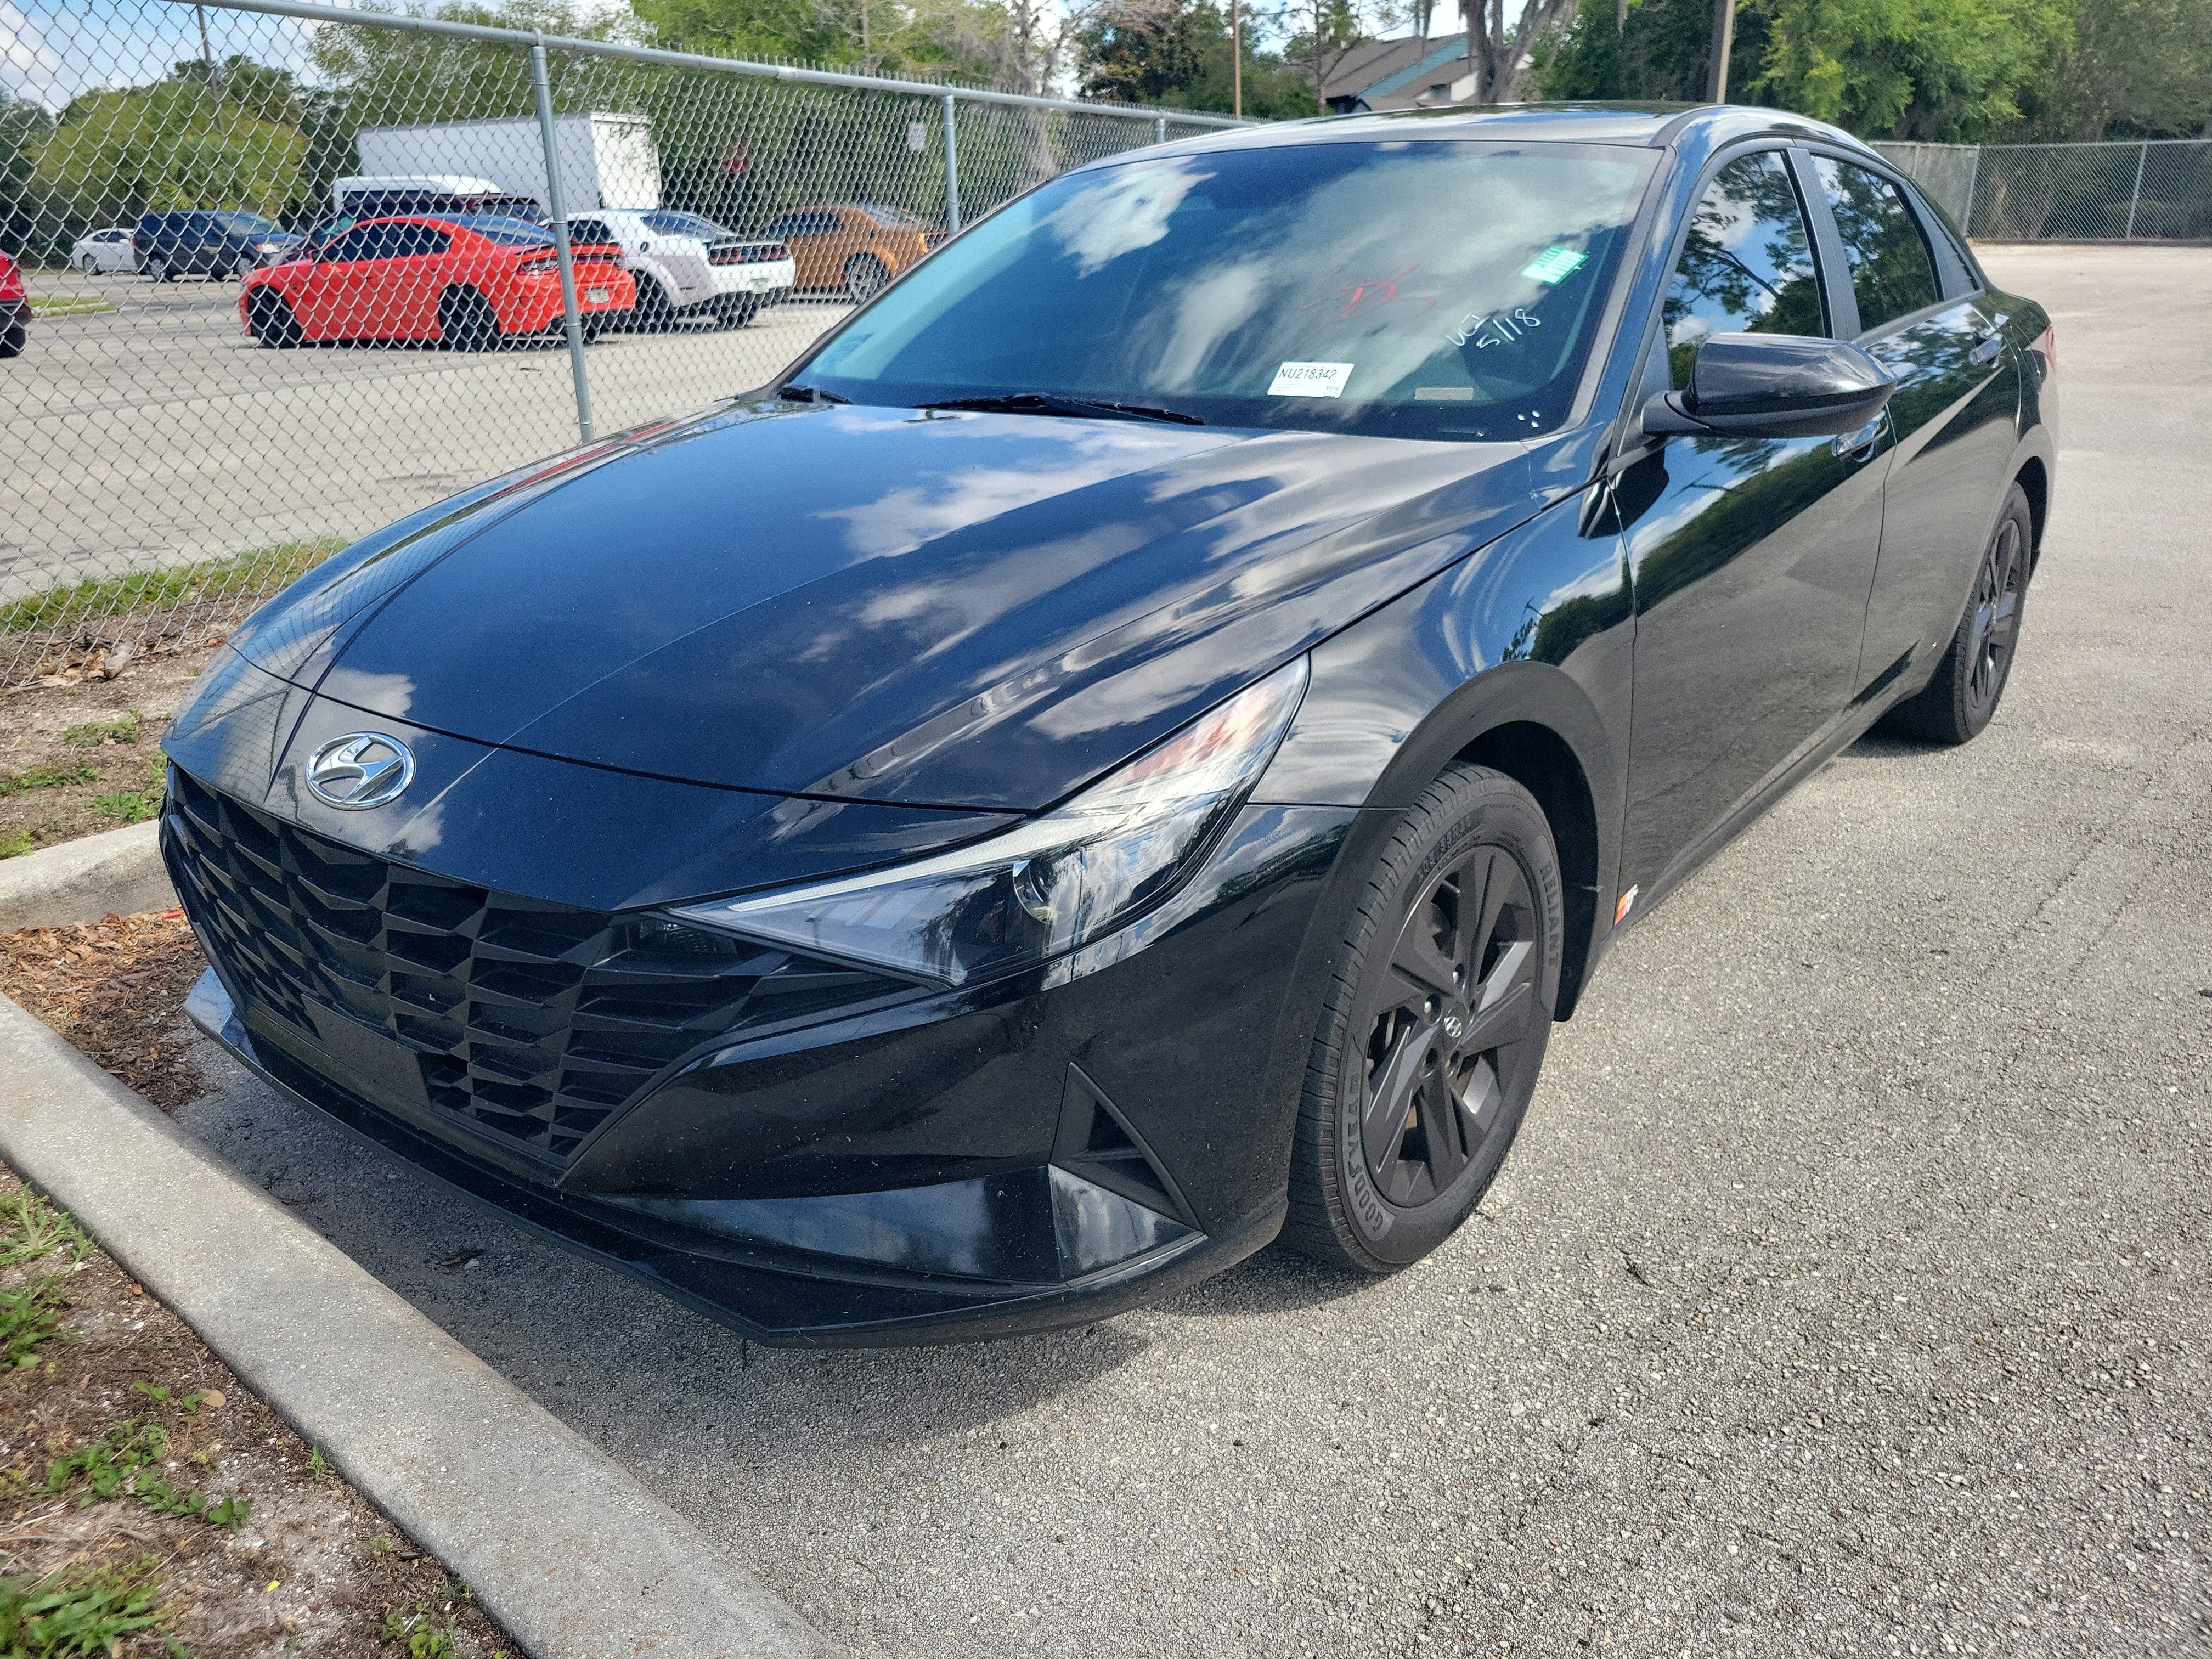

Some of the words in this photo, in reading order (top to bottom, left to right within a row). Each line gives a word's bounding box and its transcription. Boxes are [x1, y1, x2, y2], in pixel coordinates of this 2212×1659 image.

[1476, 308, 1541, 348] 5/18
[1278, 368, 1338, 380] NU218342
[1540, 860, 1560, 968] RELIANT
